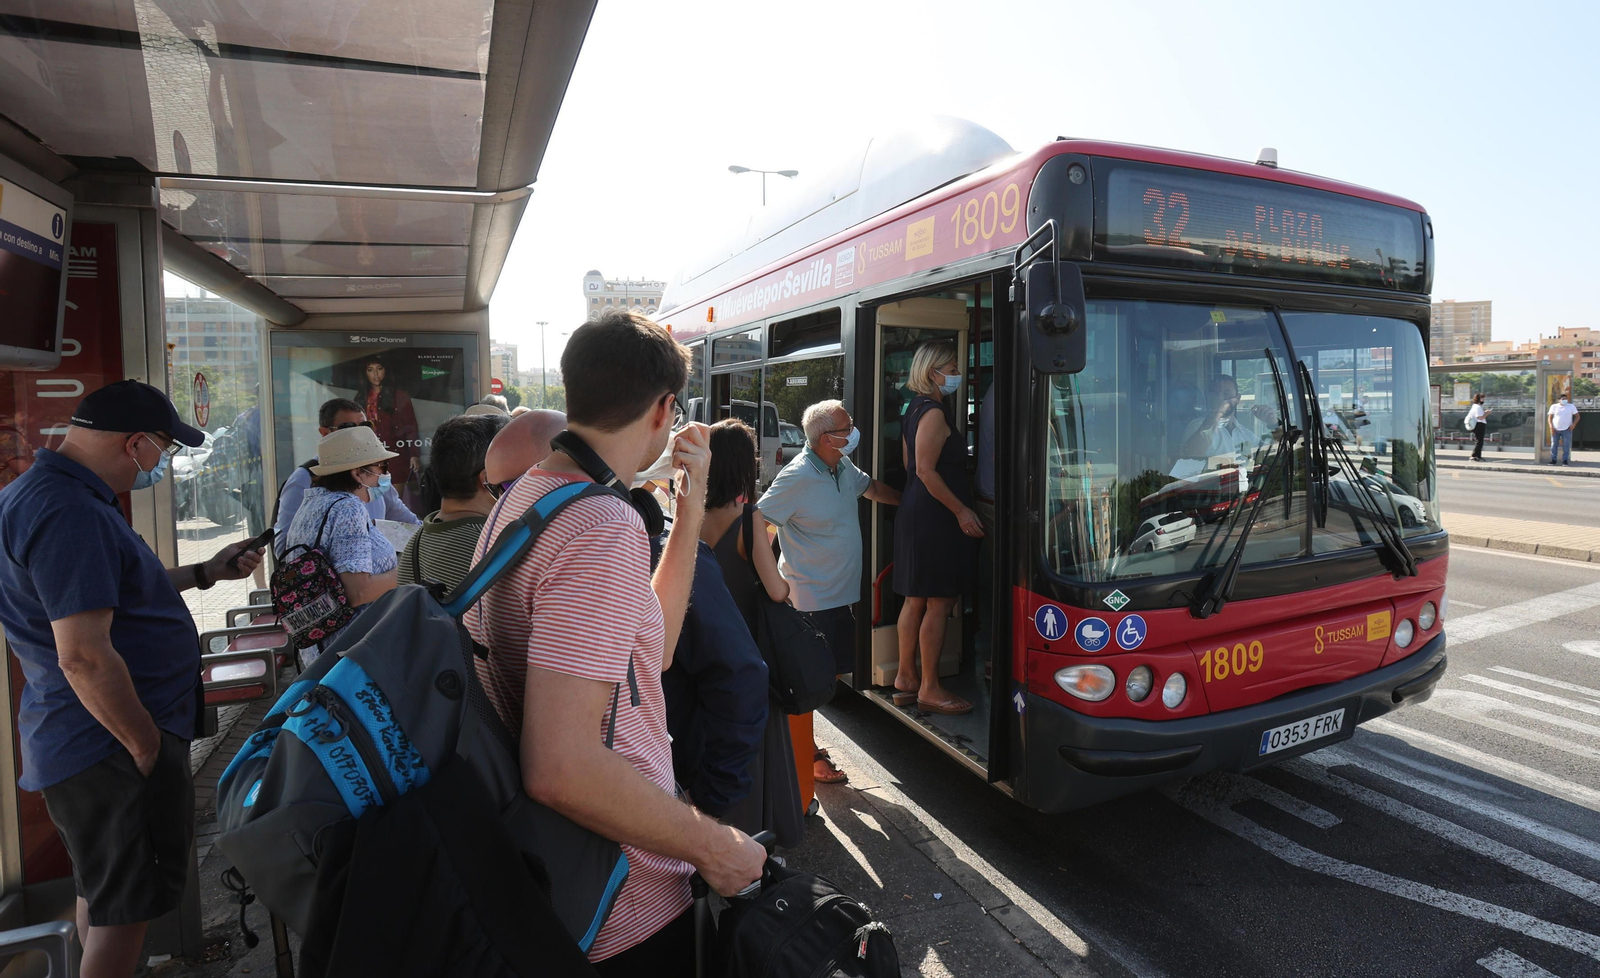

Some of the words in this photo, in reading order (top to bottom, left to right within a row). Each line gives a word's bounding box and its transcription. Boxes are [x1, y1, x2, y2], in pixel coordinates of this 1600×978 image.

[951, 183, 1020, 249] 1809
[1144, 188, 1190, 247] 32
[1255, 205, 1322, 239] PLAZA
[3, 232, 16, 244] con
[16, 236, 38, 253] destino
[38, 246, 43, 255] a
[69, 246, 97, 258] AM
[868, 238, 903, 262] TUSSAM
[49, 249, 60, 262] Min.
[396, 437, 433, 448] OTOÑ
[1107, 596, 1125, 605] GNC
[1327, 624, 1364, 644] TUSSAM
[1200, 640, 1264, 683] 1809
[1271, 722, 1310, 749] 0353
[1313, 712, 1342, 737] FRK
